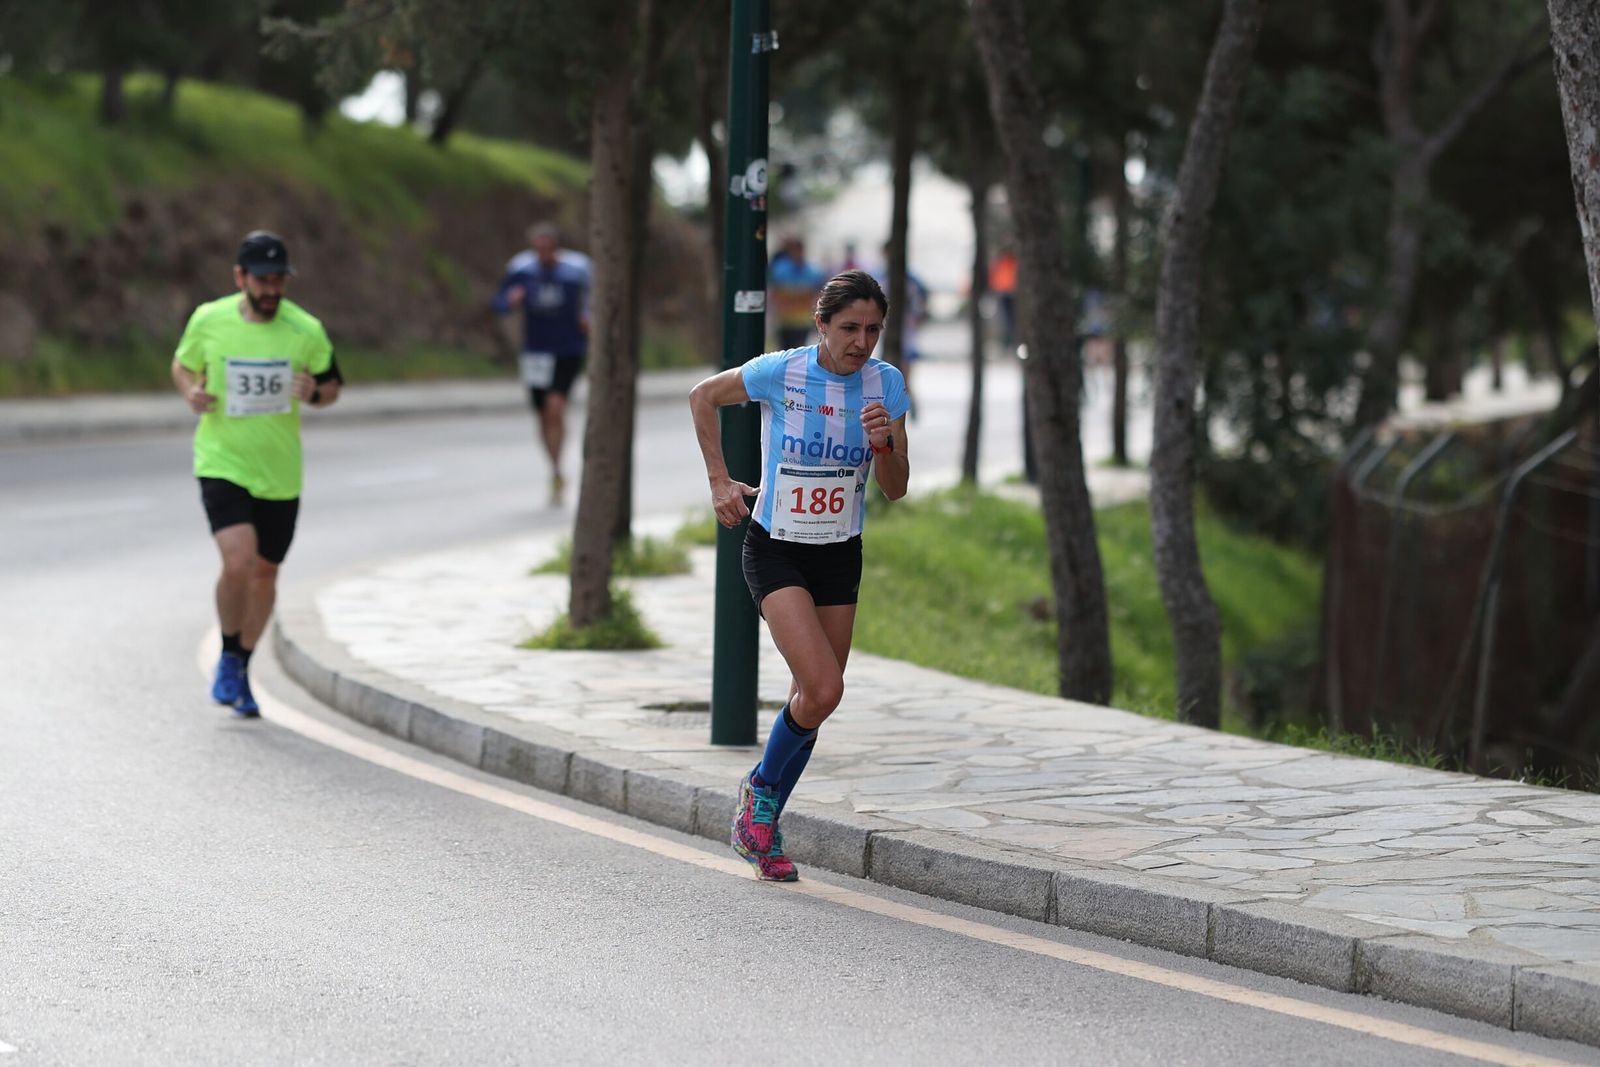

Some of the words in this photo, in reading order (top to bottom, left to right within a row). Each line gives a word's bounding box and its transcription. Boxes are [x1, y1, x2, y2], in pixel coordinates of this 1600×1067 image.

[237, 374, 282, 396] 336
[785, 386, 807, 395] vive
[790, 487, 845, 515] 186
